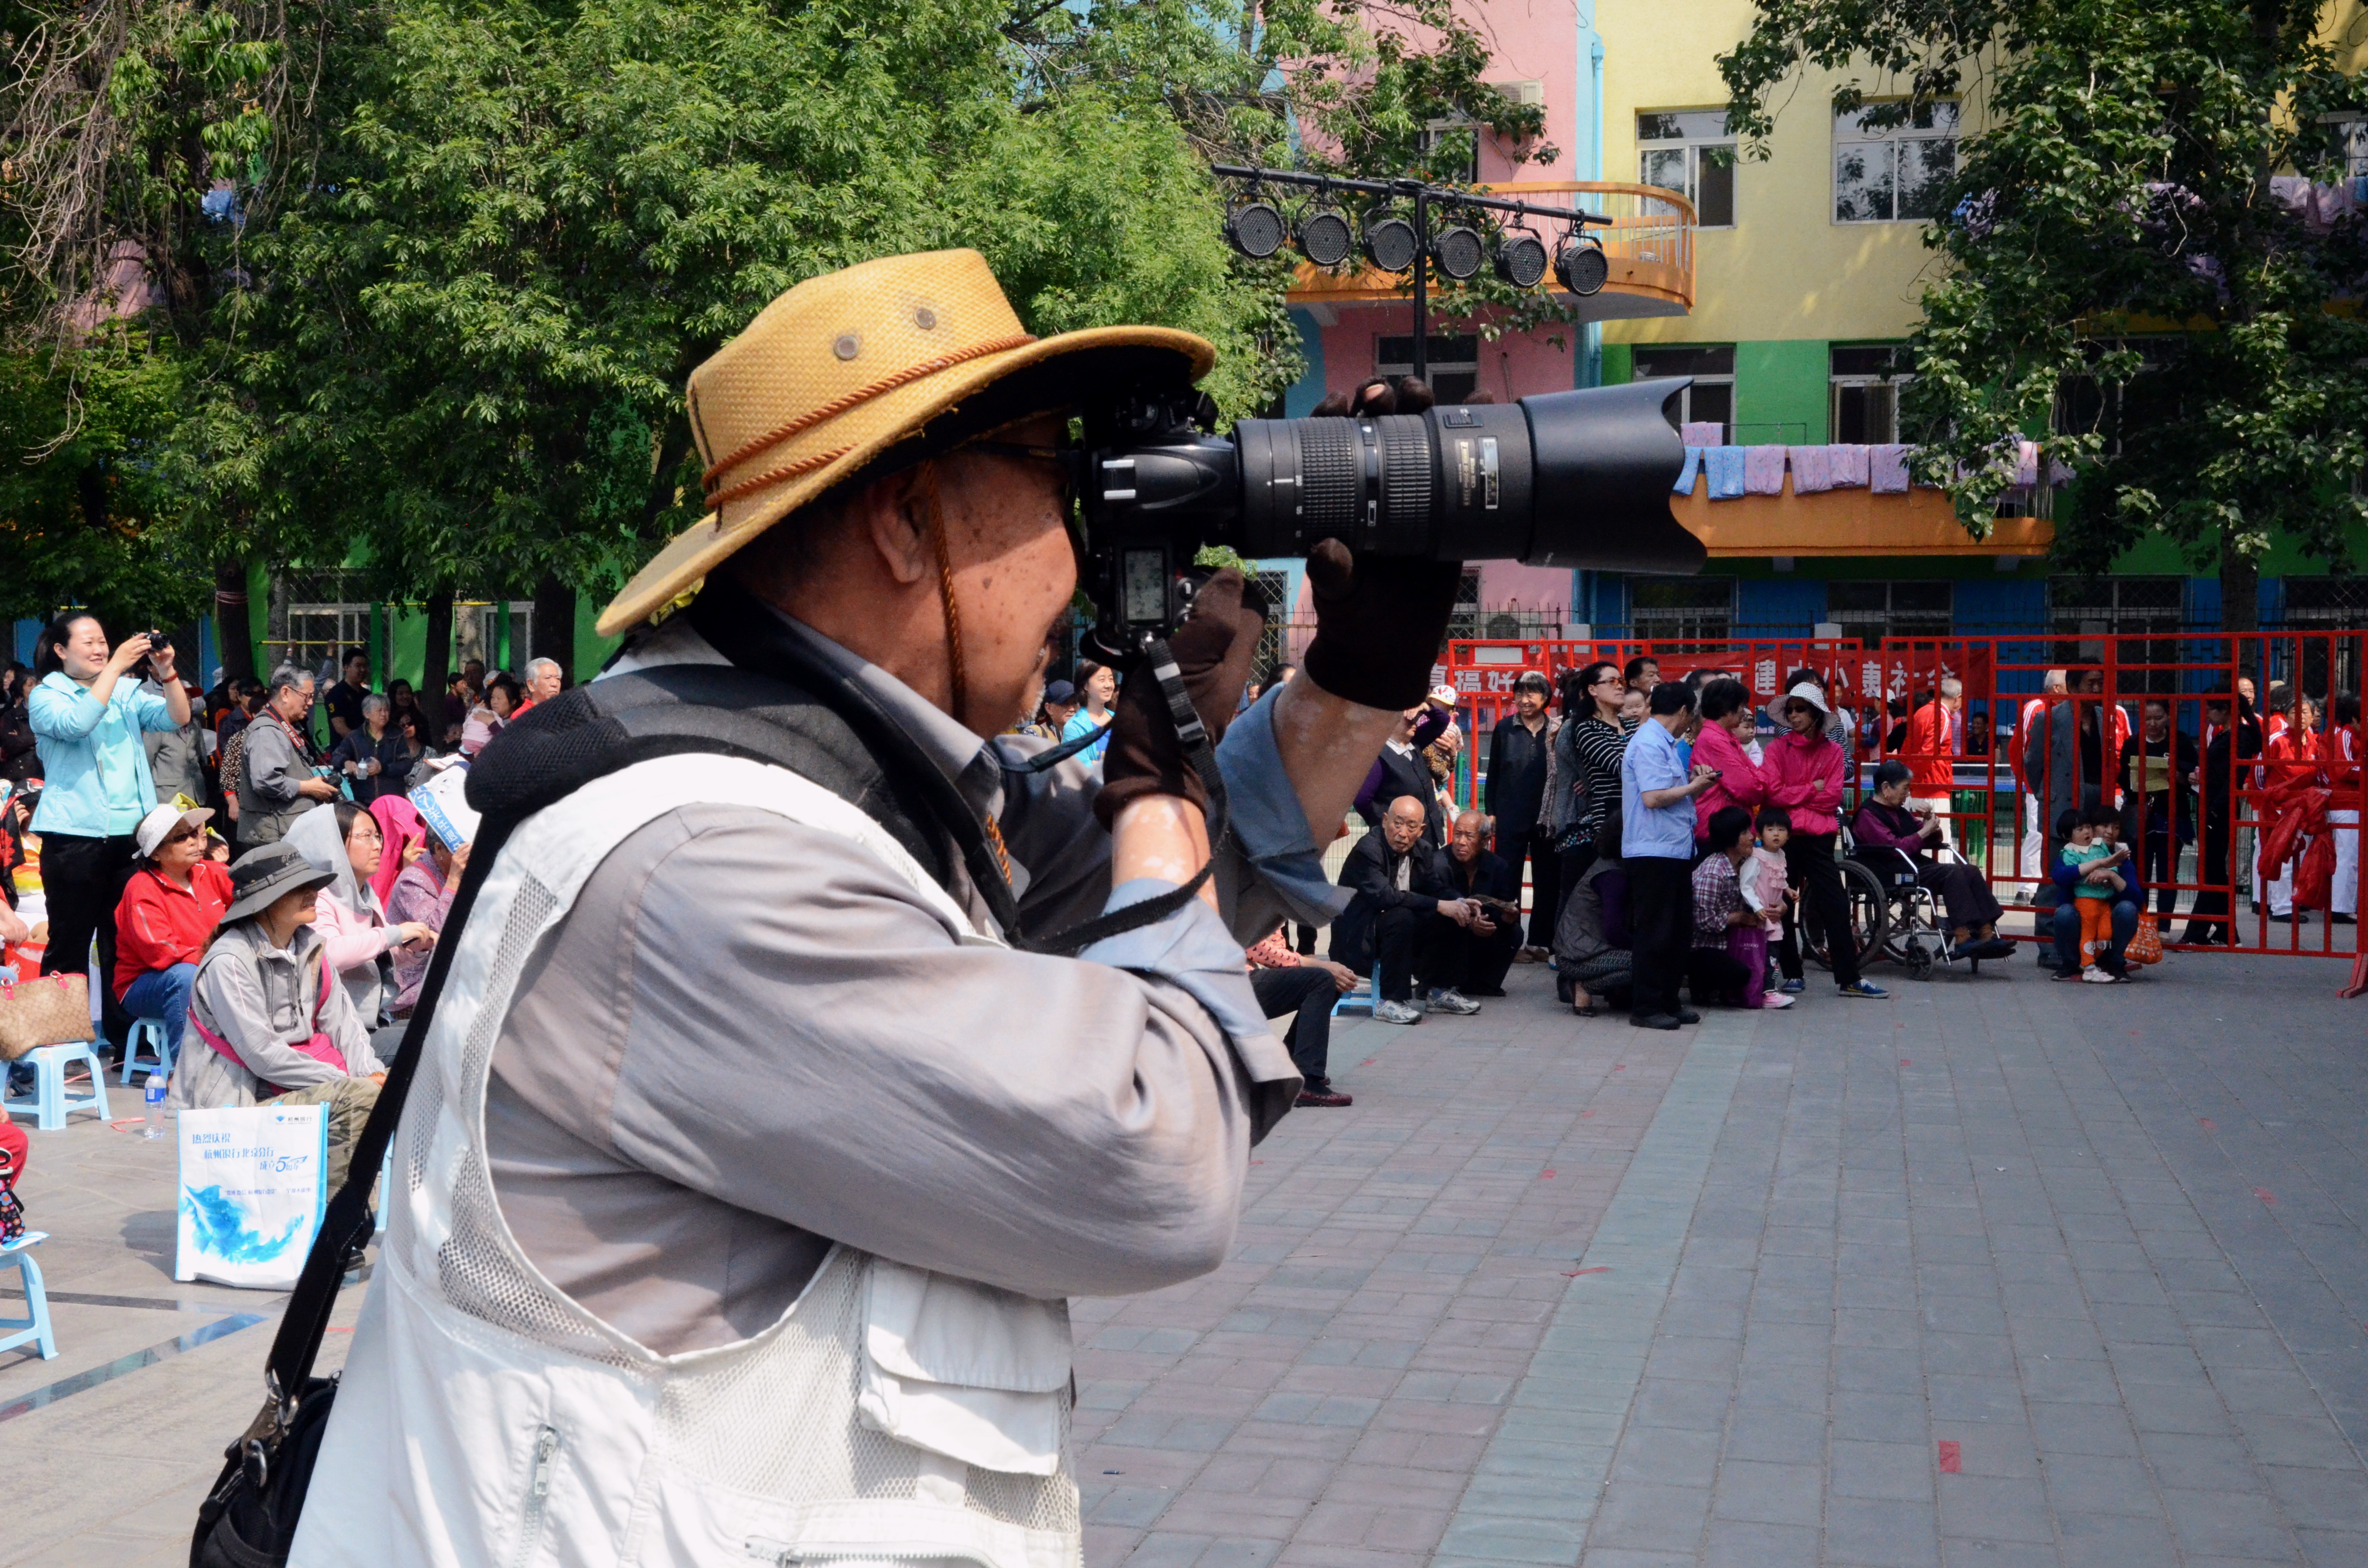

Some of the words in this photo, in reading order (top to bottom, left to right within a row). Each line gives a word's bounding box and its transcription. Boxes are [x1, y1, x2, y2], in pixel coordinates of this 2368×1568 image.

[192, 1133, 231, 1144] 热烈庆祝
[204, 1147, 274, 1159] 杭州银行北京分行
